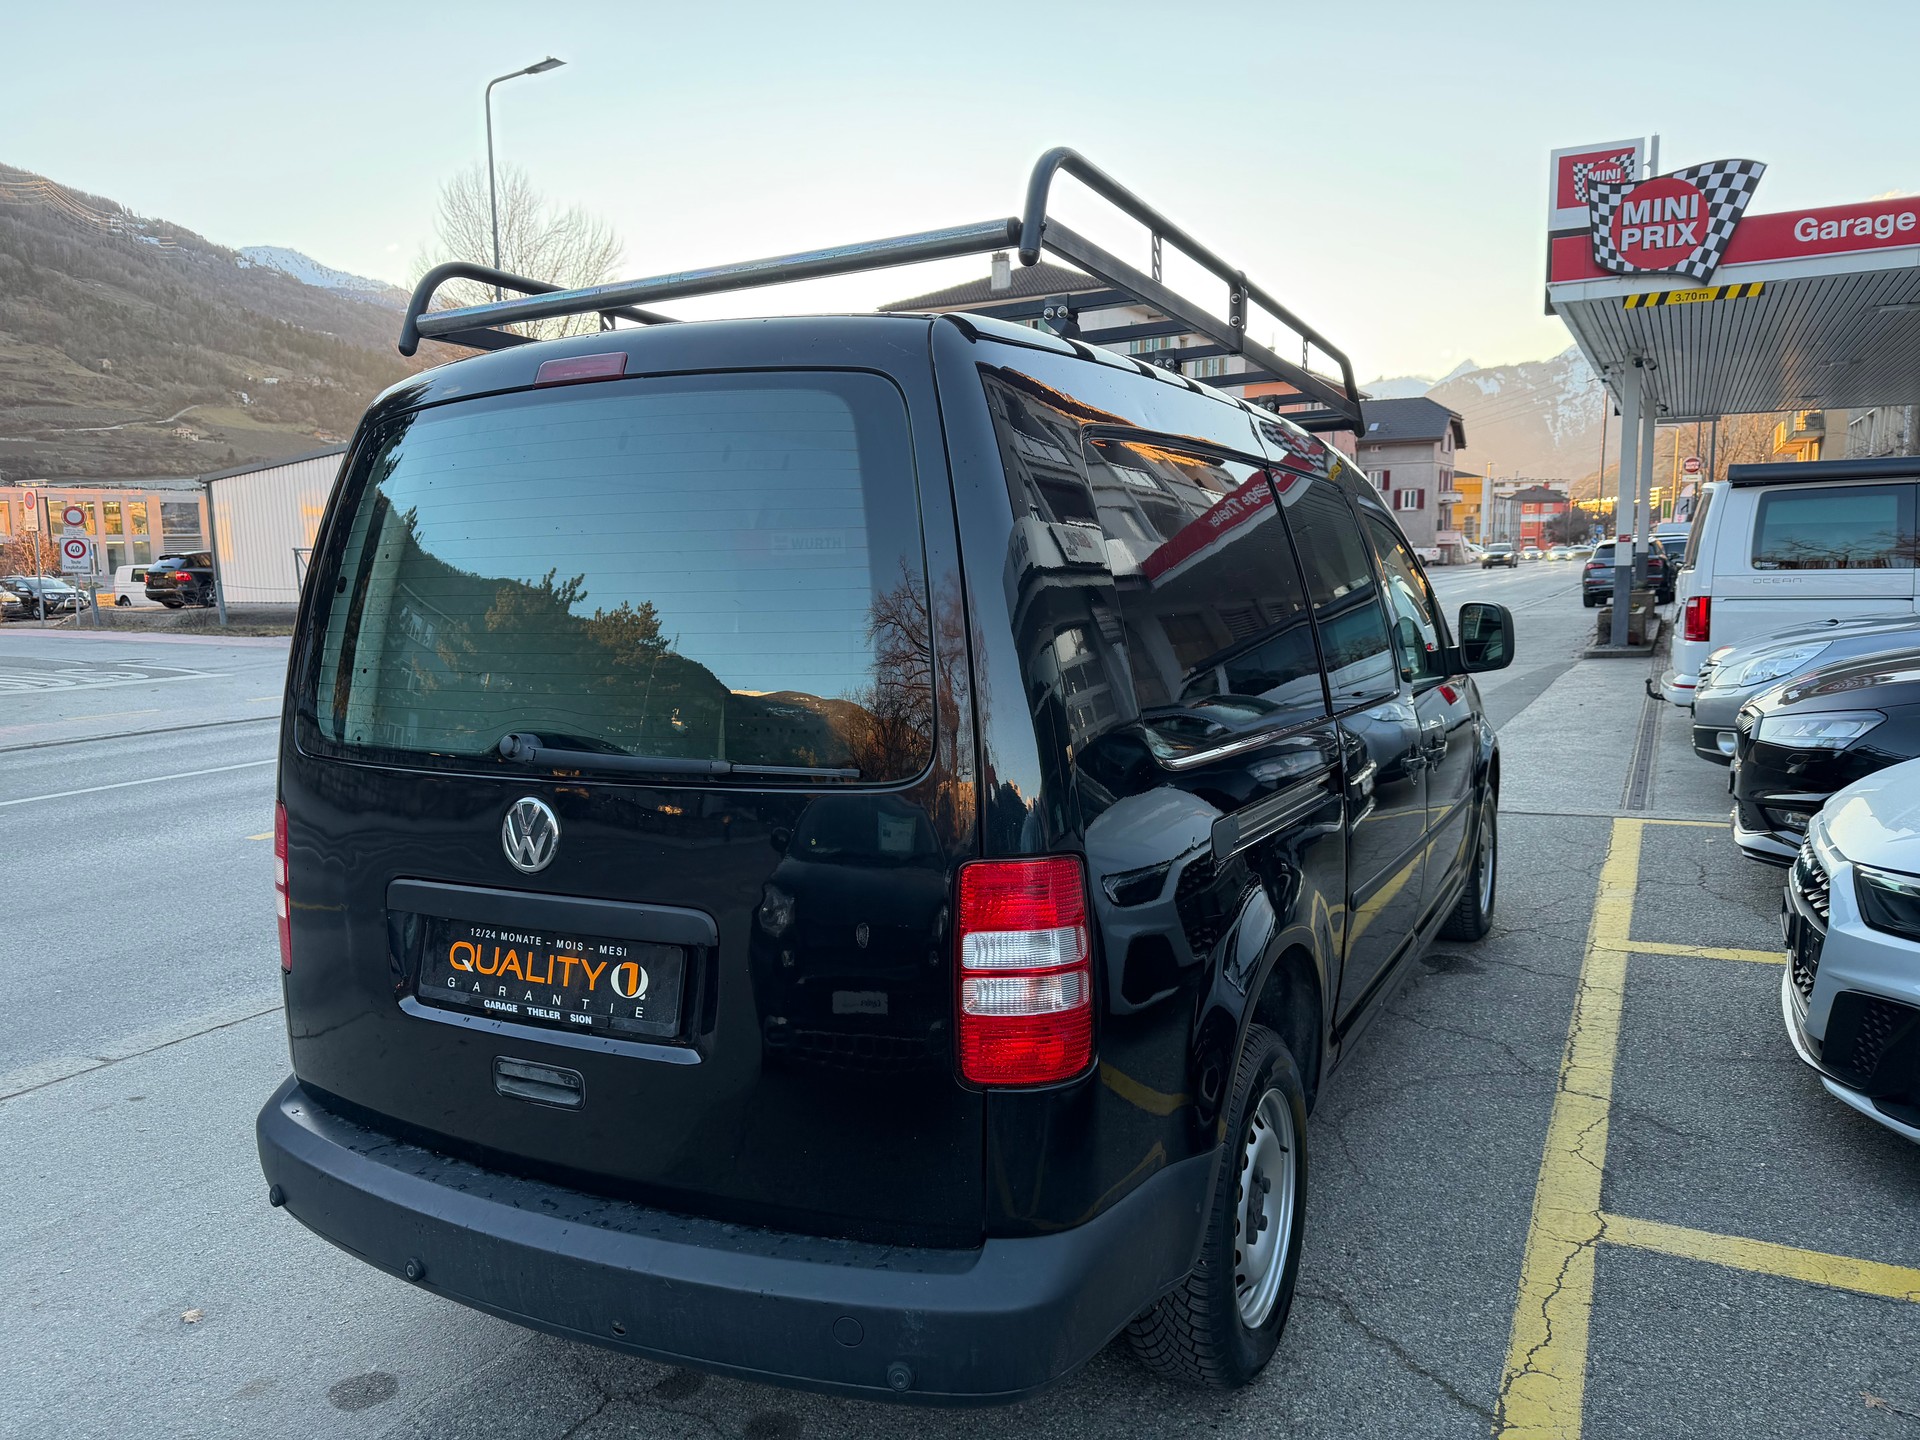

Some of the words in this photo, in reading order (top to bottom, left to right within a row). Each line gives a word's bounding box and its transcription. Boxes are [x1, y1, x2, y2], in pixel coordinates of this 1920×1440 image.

[1588, 168, 1621, 181] MINI
[1622, 193, 1699, 226] MINI
[1621, 221, 1698, 252] PRIX
[1794, 212, 1917, 242] Garage
[70, 545, 80, 553] 40
[470, 928, 496, 940] 12/24
[500, 932, 542, 946] MONATE
[556, 939, 584, 951] MOIS
[599, 945, 627, 957] MESI
[449, 940, 608, 991] QUALITY
[447, 977, 644, 1018] GARANTIE
[484, 999, 518, 1013] GARAGE
[527, 1007, 560, 1020] THELER
[570, 1013, 592, 1025] SION
